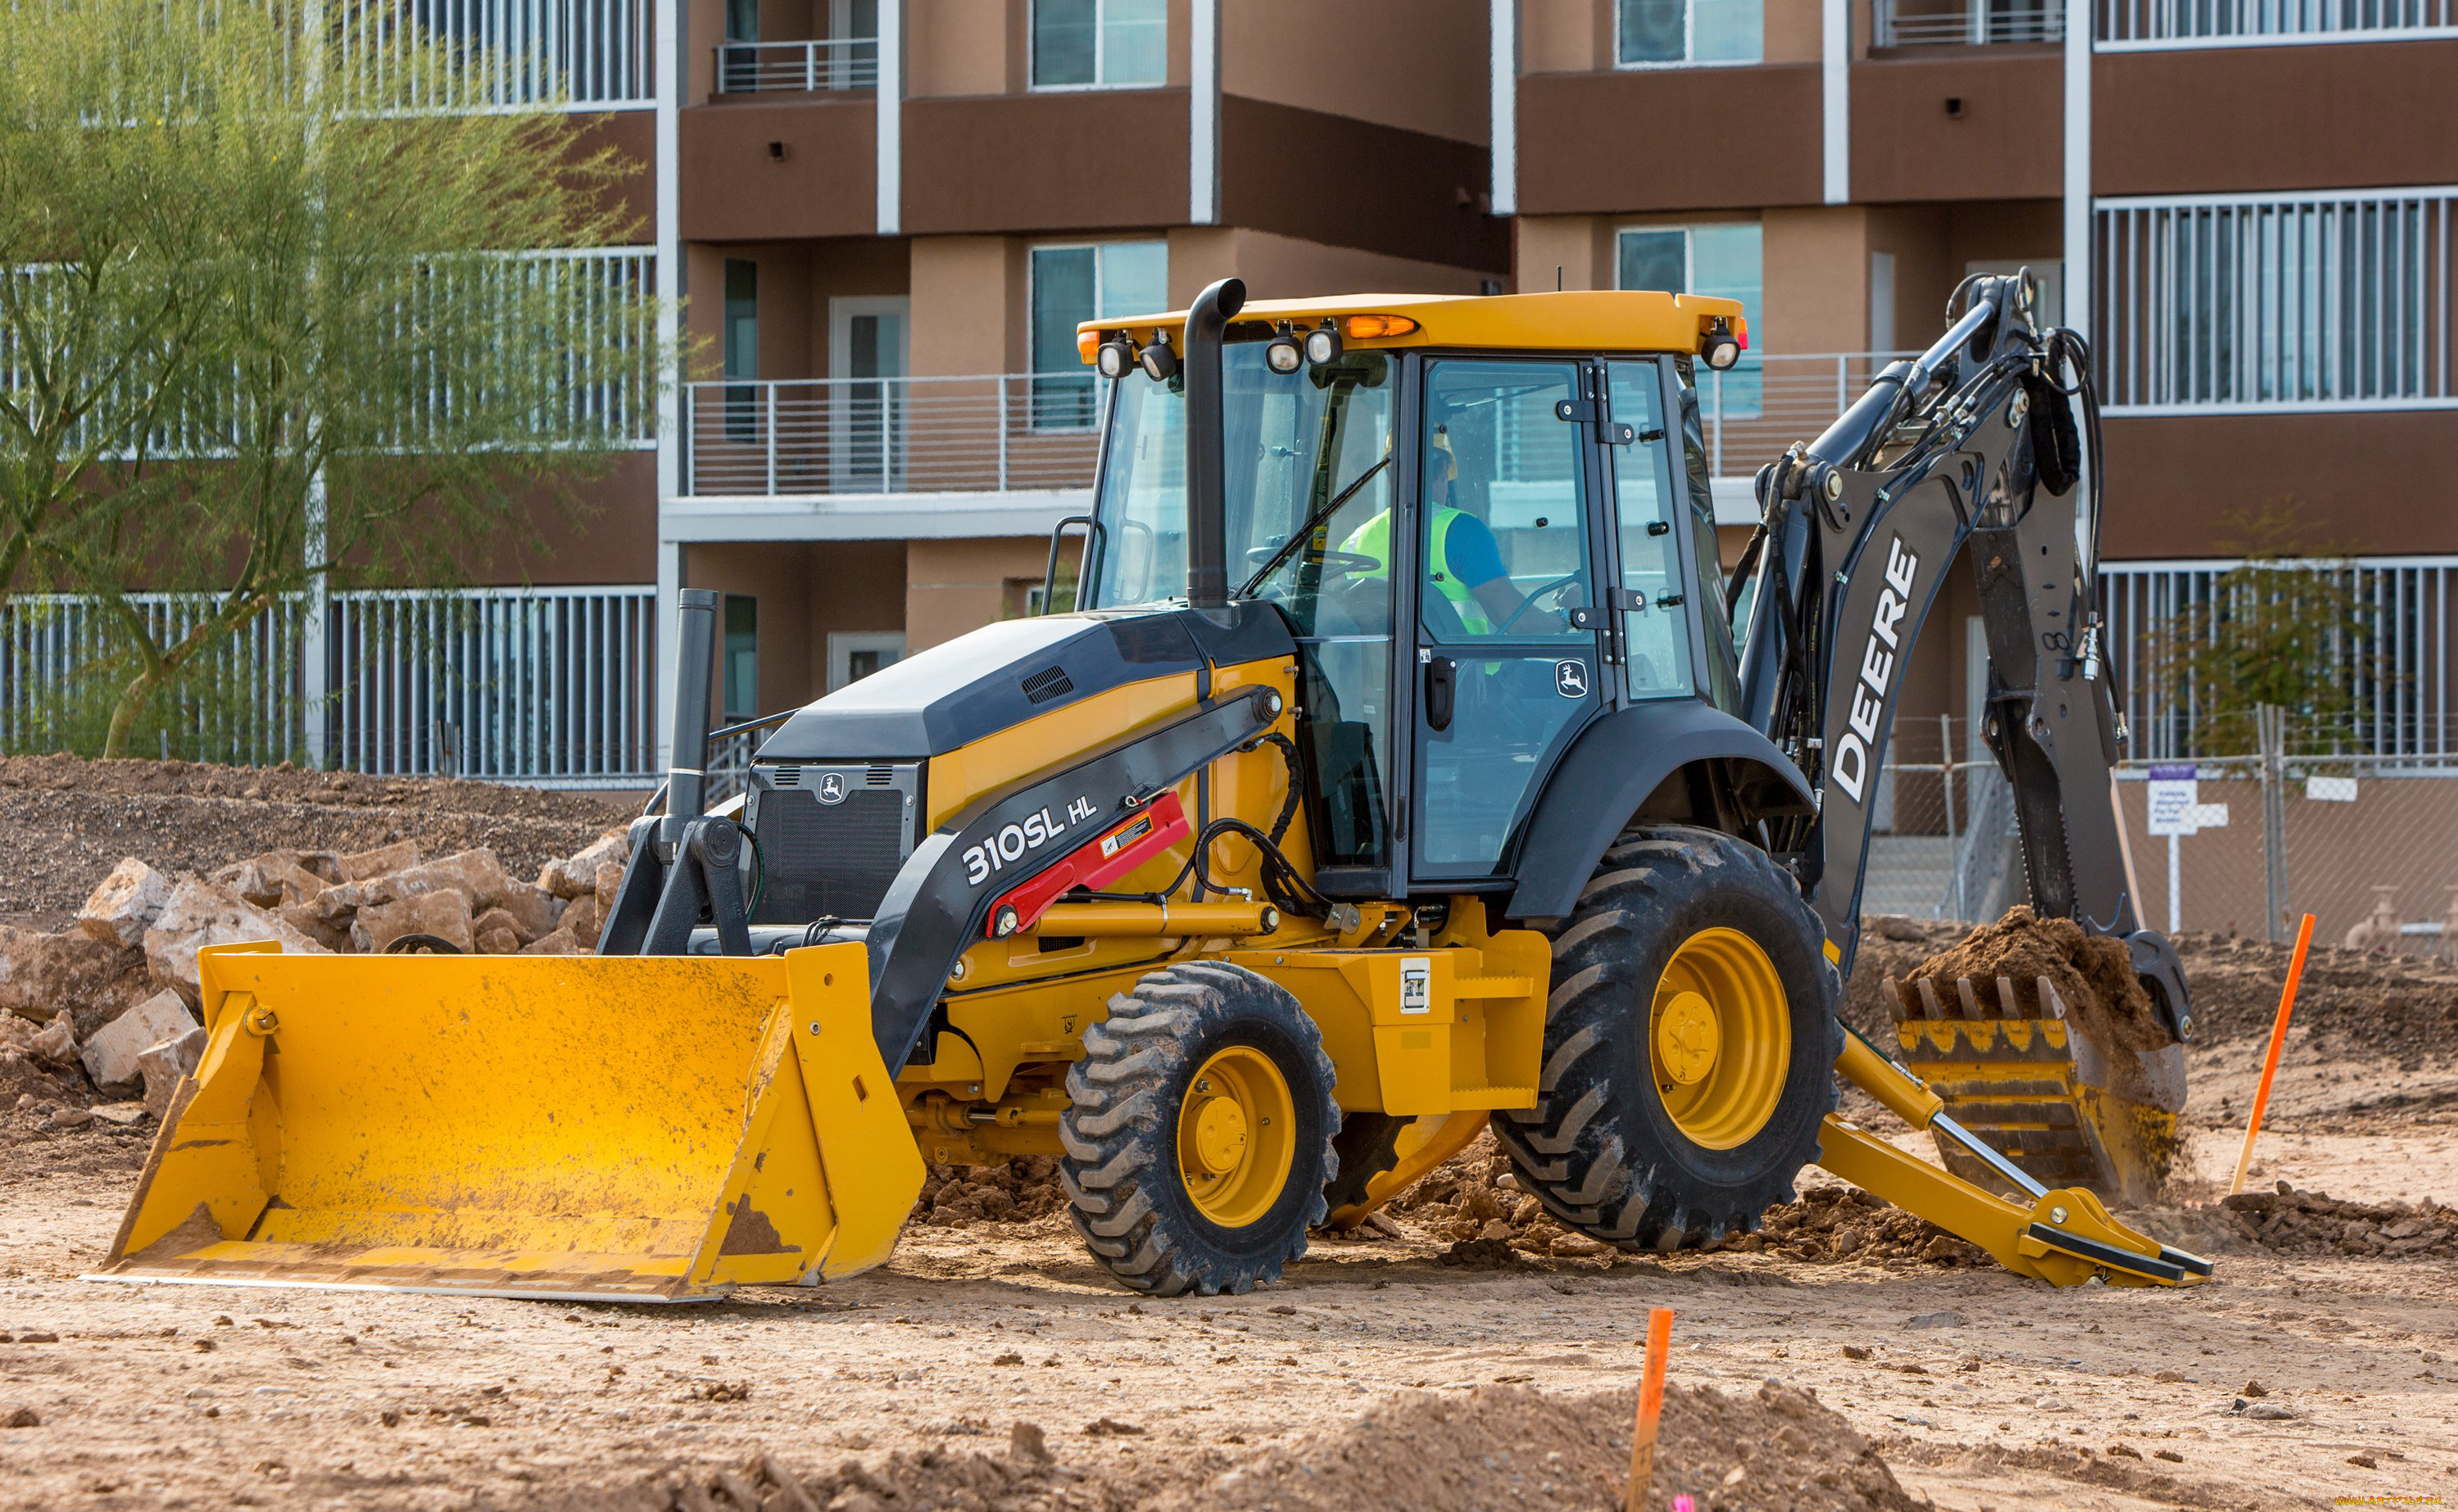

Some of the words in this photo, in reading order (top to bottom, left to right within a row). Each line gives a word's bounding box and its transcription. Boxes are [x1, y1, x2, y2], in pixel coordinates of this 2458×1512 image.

[1832, 536, 1917, 803] DEERE
[962, 807, 1065, 885] 310SL
[1067, 795, 1097, 826] HL
